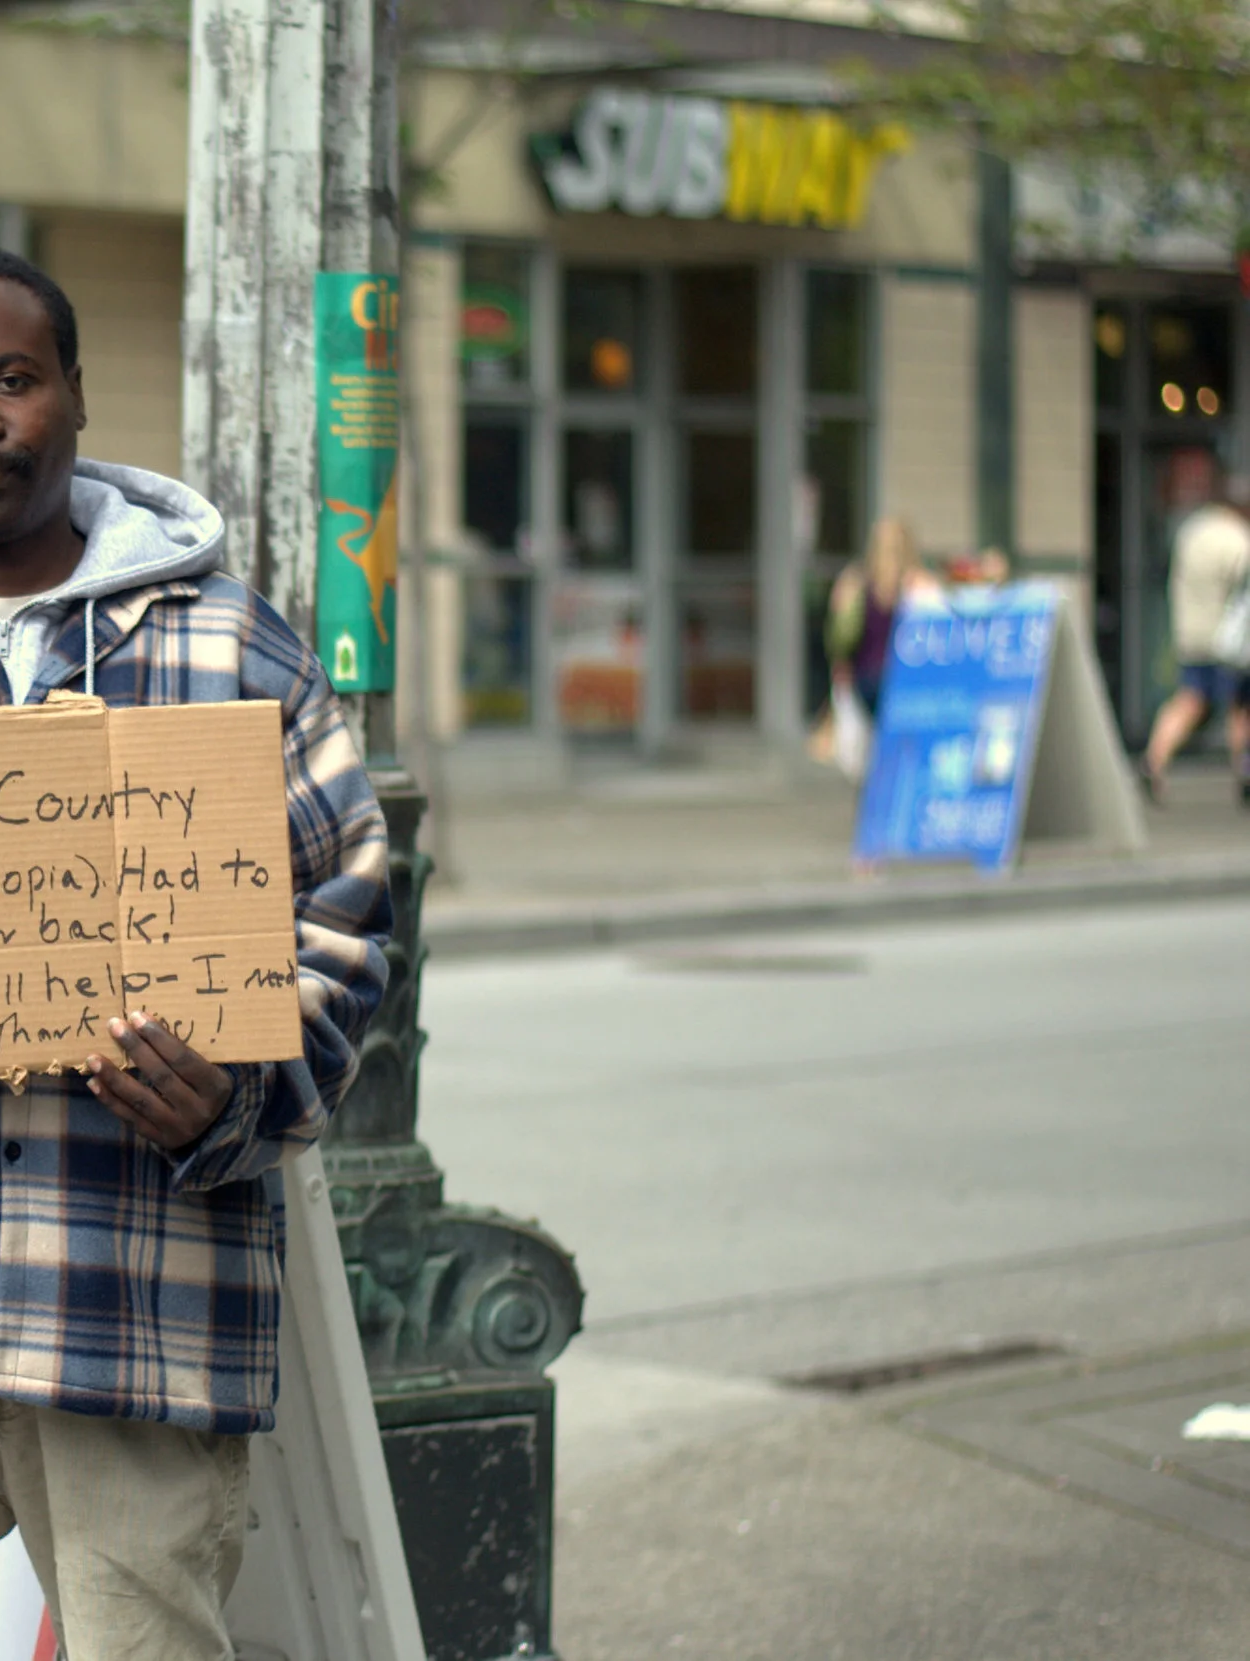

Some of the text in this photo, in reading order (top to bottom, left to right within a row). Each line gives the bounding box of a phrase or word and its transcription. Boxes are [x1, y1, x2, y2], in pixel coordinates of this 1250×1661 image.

[550, 87, 910, 228] SUBWAY
[117, 846, 200, 896] Had
[221, 848, 269, 889] to
[39, 895, 176, 944] back!
[192, 954, 228, 994] I
